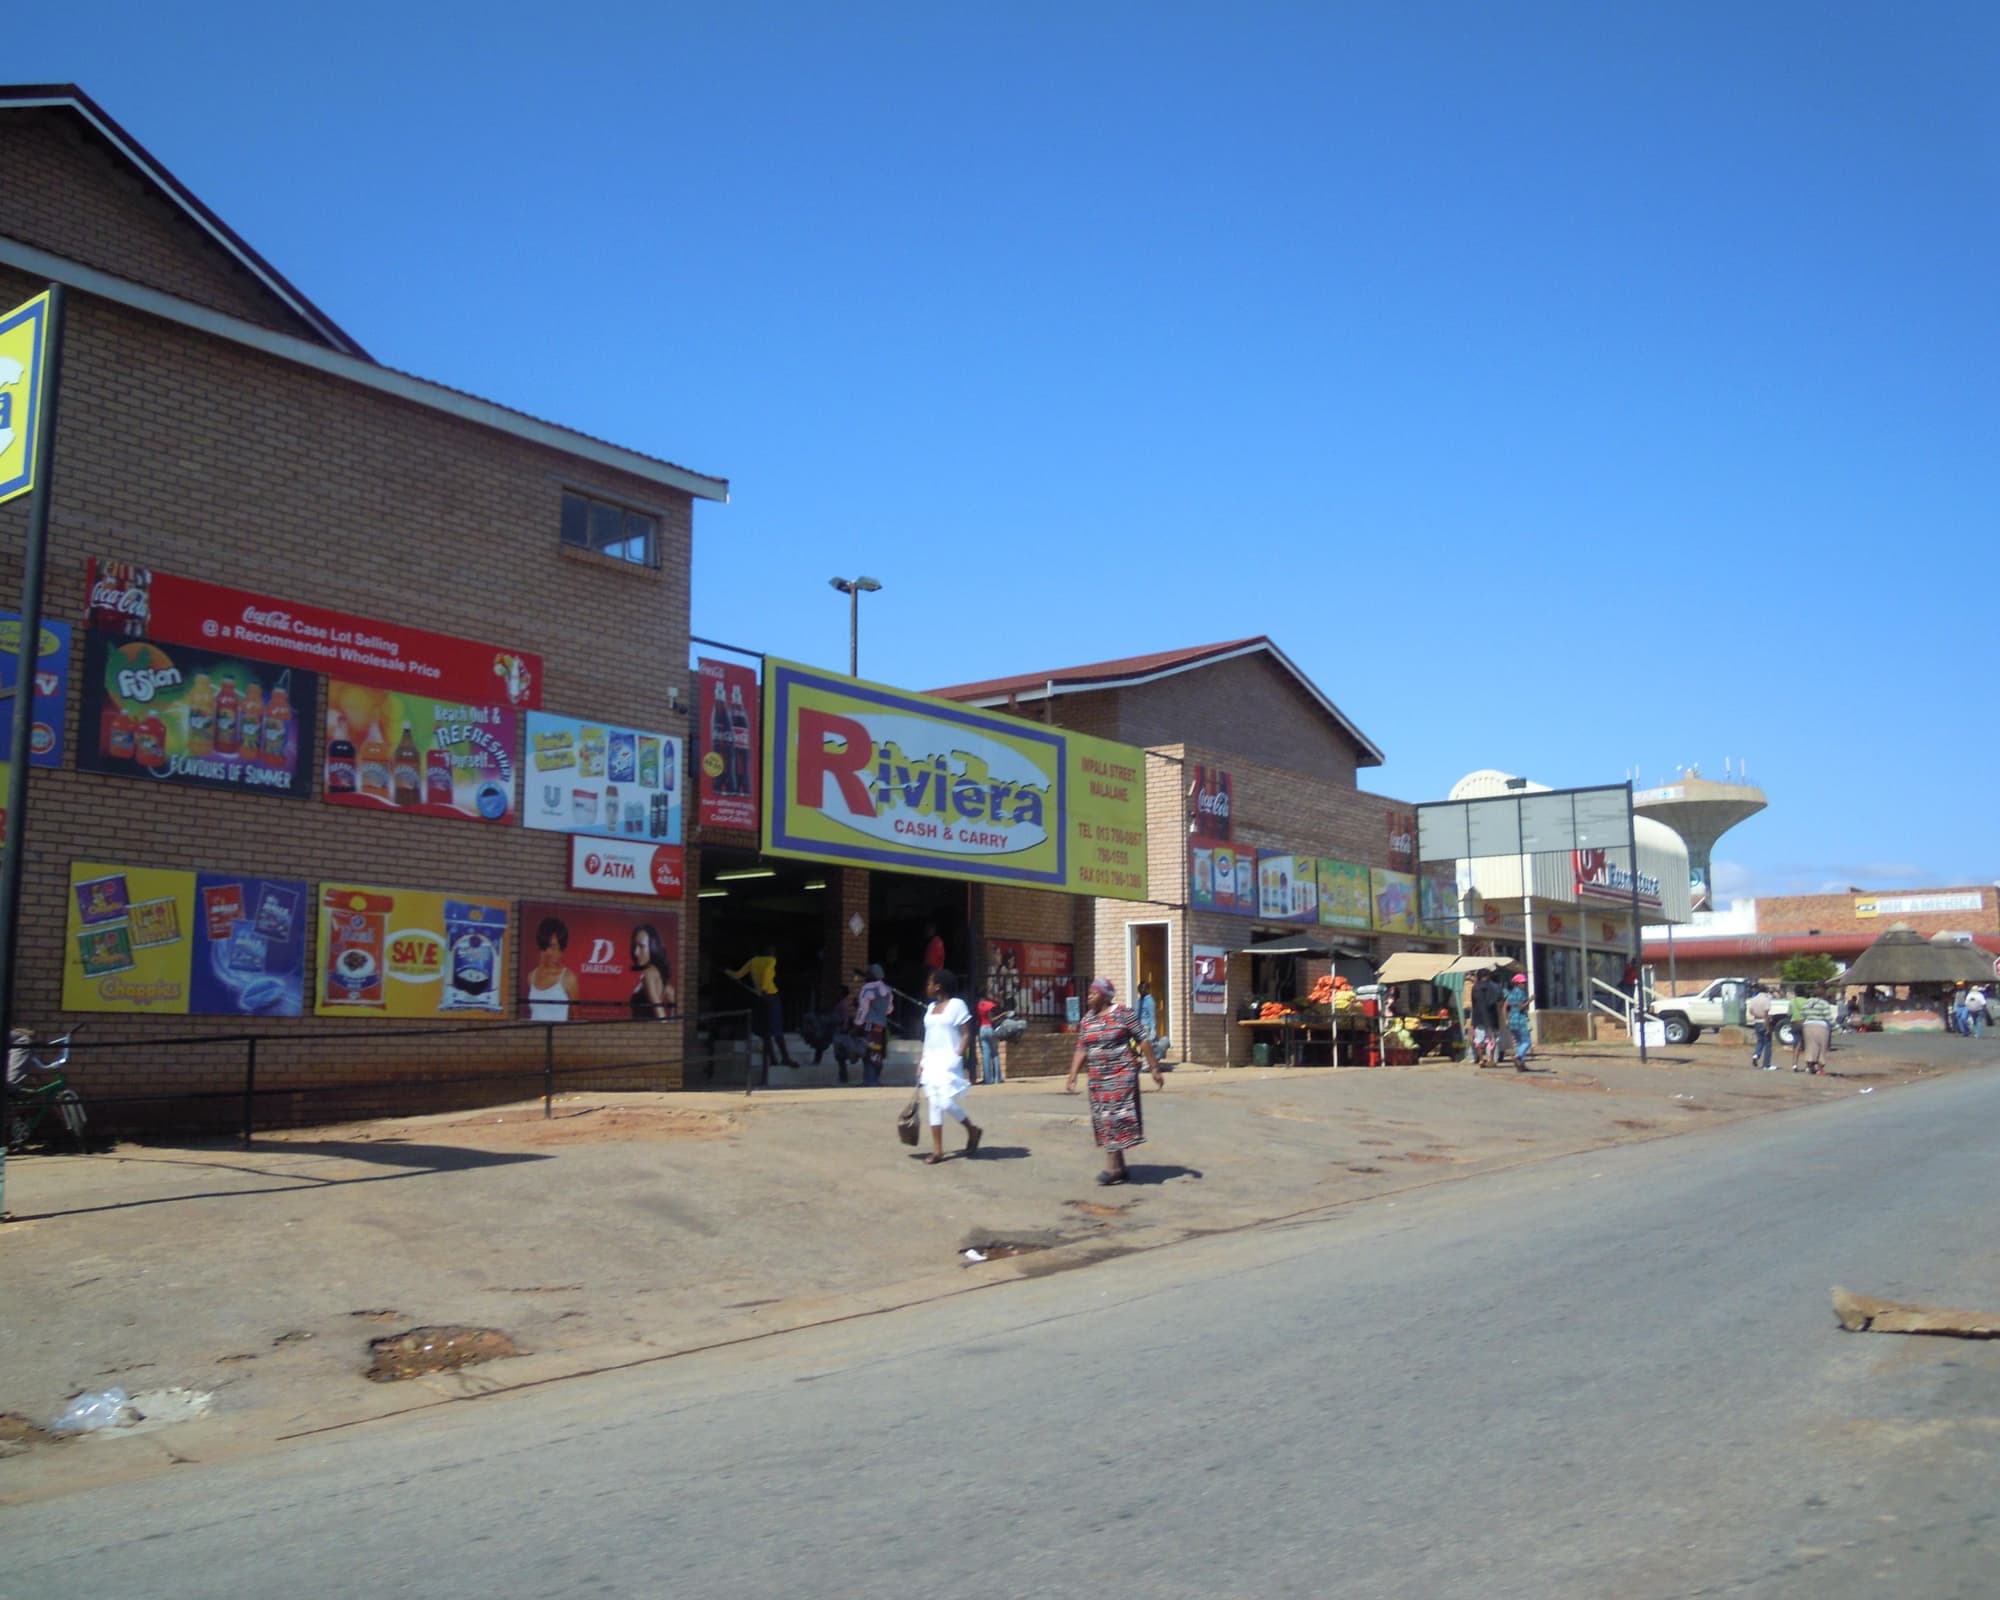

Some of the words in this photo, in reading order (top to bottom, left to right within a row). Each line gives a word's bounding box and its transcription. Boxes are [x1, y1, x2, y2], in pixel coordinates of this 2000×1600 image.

[91, 581, 147, 617] Coca-Cola
[202, 619, 219, 637] @
[221, 626, 231, 637] a
[234, 625, 337, 658] Recommended
[340, 647, 406, 671] Wholesale
[408, 660, 441, 679] Price
[293, 620, 327, 639] Case
[330, 628, 352, 644] Lot
[355, 632, 398, 656] Selling
[228, 765, 242, 781] OF
[245, 765, 291, 789] SUMMER
[797, 707, 1043, 827] Riviera
[1198, 788, 1229, 817] Coca-Cola
[894, 819, 938, 839] CASH
[943, 826, 954, 841] &
[959, 828, 1008, 849] CARRY
[602, 862, 636, 879] ATM
[391, 941, 438, 965] SAVE
